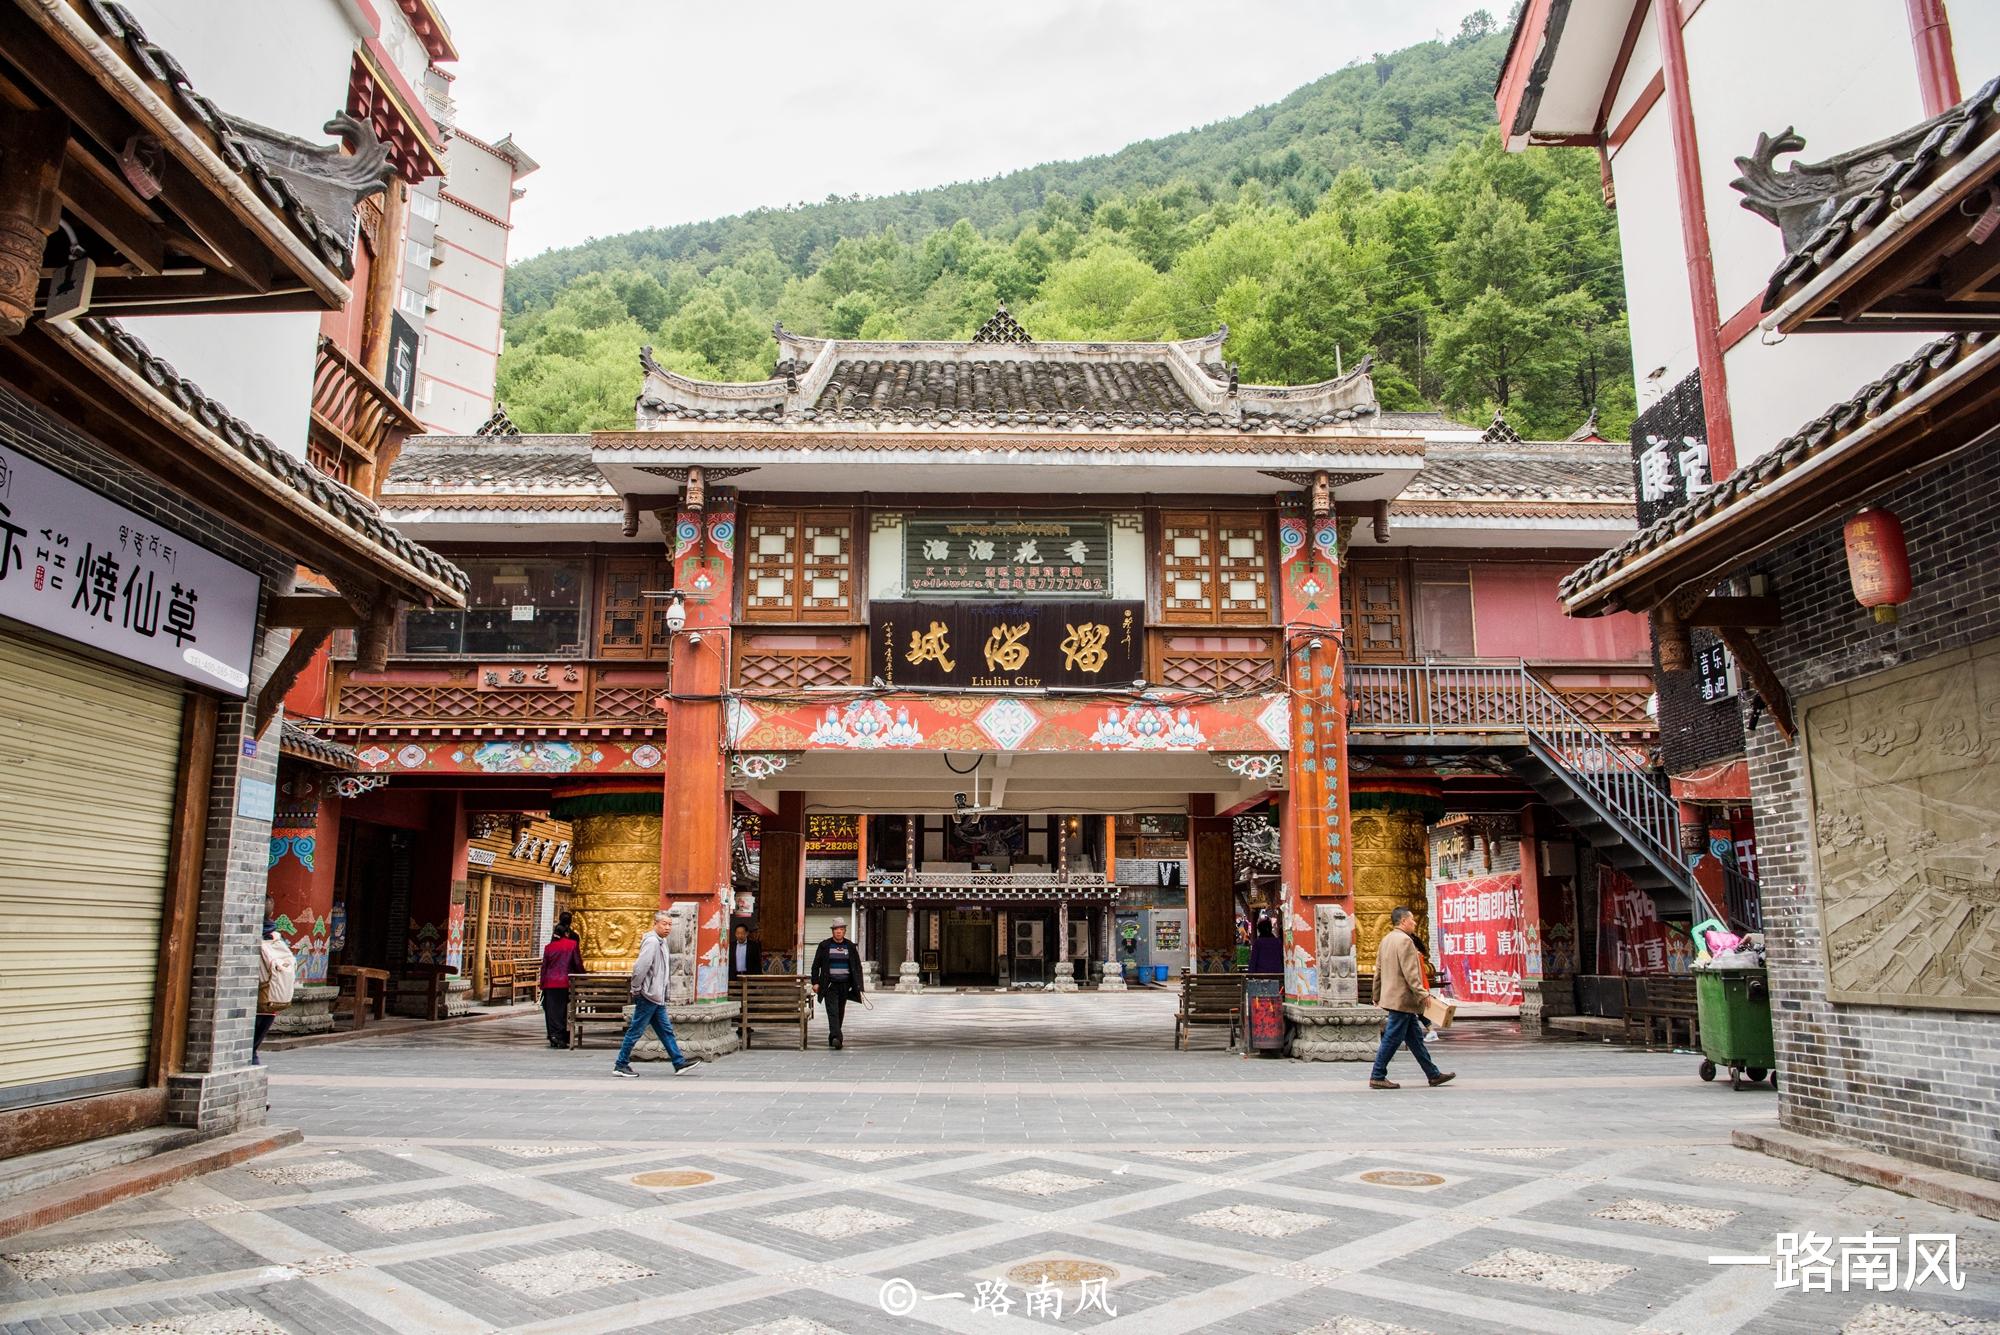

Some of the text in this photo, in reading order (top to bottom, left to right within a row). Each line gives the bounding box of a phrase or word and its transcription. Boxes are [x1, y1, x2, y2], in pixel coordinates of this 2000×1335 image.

[1641, 435, 1712, 501] 康定
[1700, 648, 1722, 675] 音乐
[972, 676, 1041, 688] Liuliu City
[1702, 676, 1725, 699] 酒吧
[1442, 889, 1525, 923] 立成电脑即将
[1443, 930, 1527, 956] 施工重地 请勿
[1469, 969, 1522, 996] 注意安全
